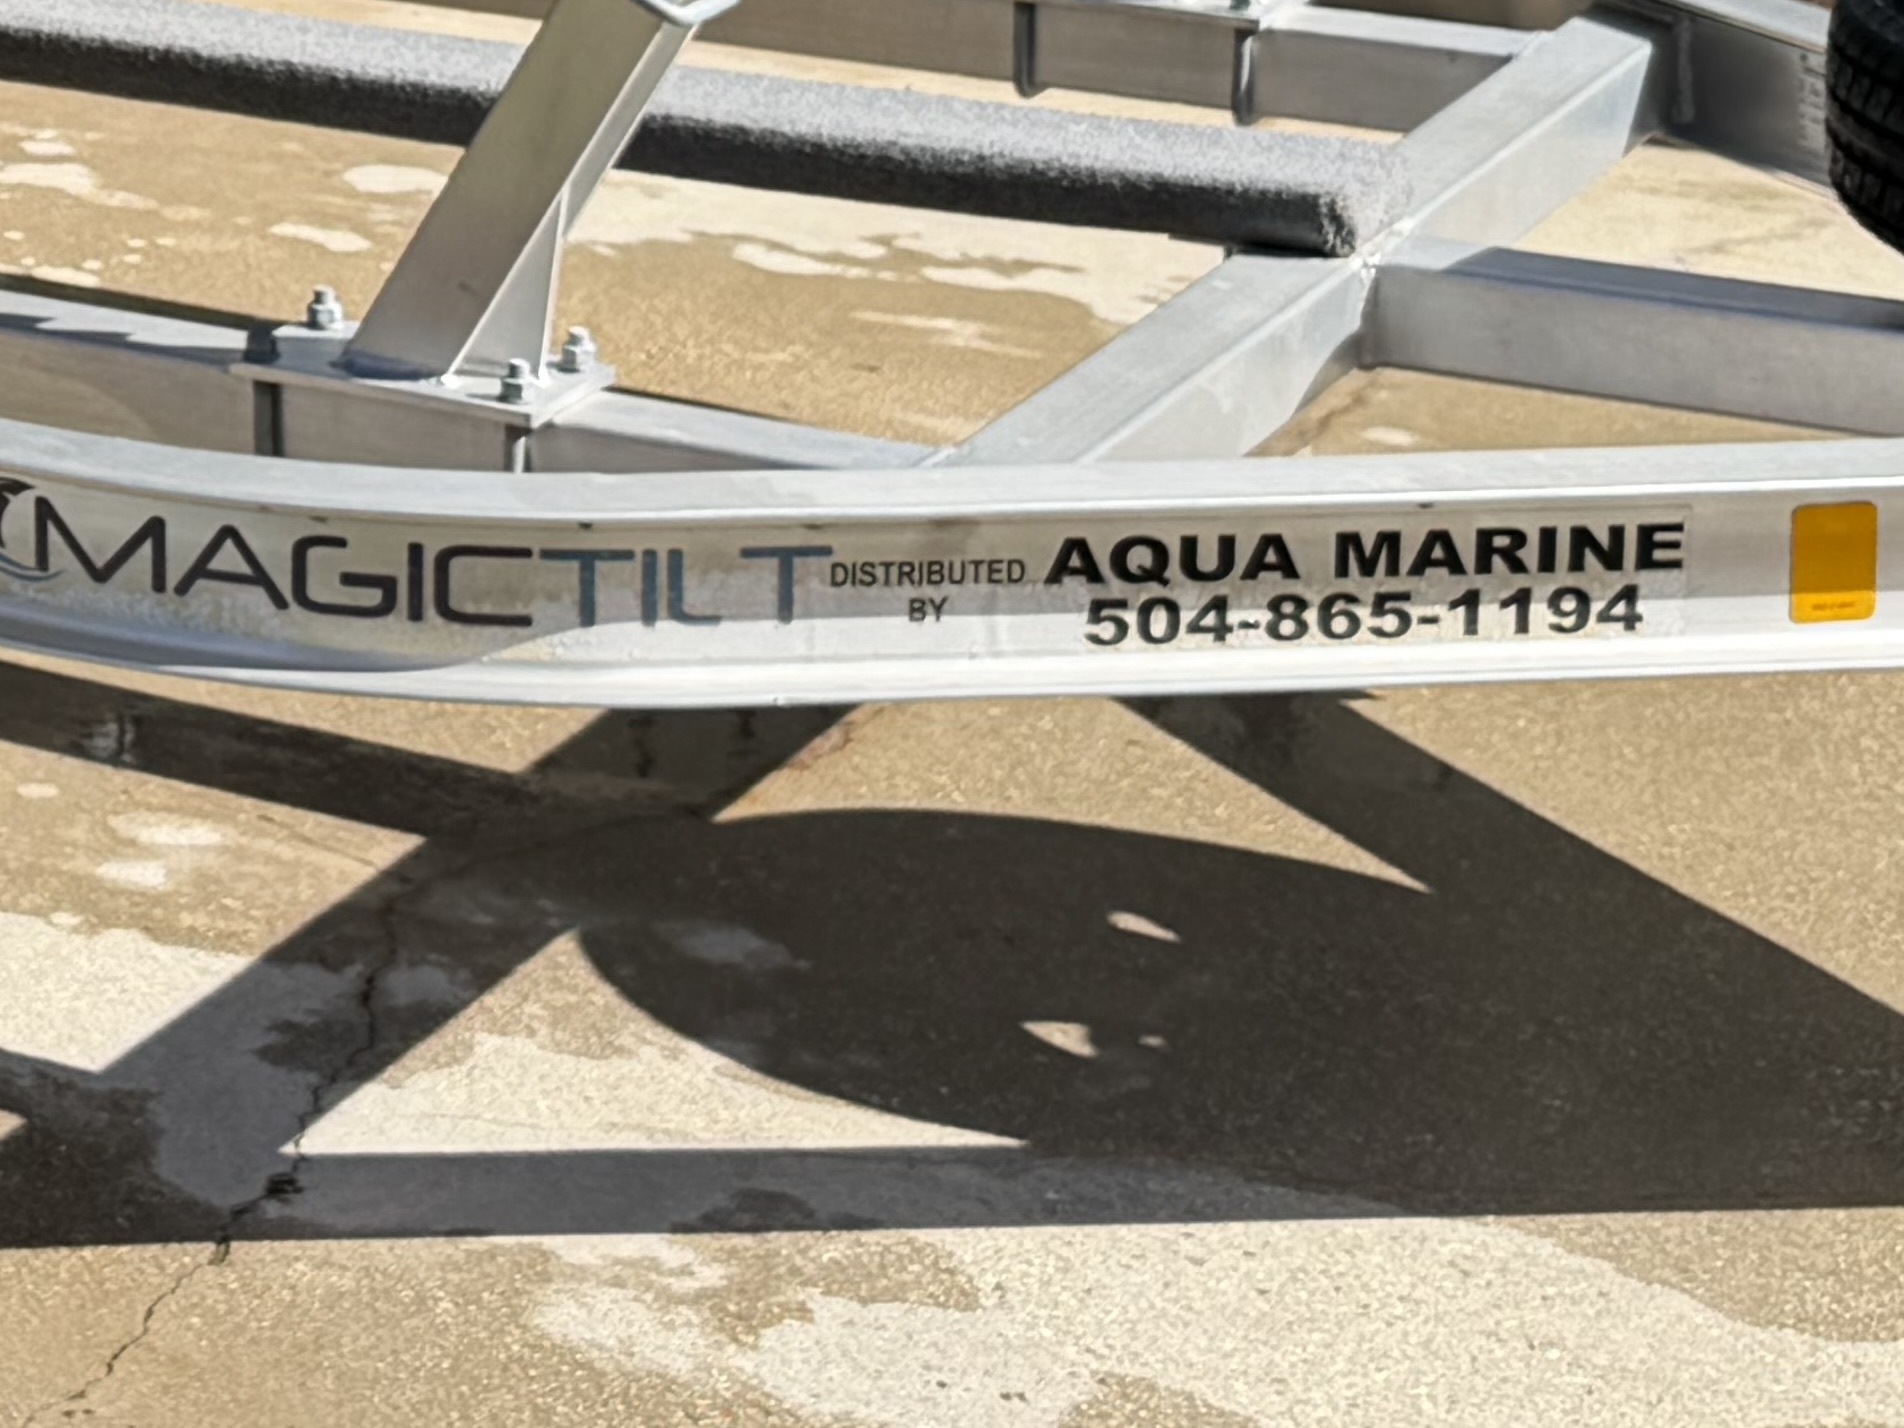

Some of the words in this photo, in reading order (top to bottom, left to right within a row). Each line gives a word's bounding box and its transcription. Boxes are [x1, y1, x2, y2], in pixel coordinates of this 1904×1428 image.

[830, 559, 1026, 587] DISTRIBUTED
[1043, 533, 1301, 588] AQUA
[1334, 522, 1685, 579] MARINE
[908, 596, 949, 623] BY
[1084, 584, 1644, 646] 504-865-1194
